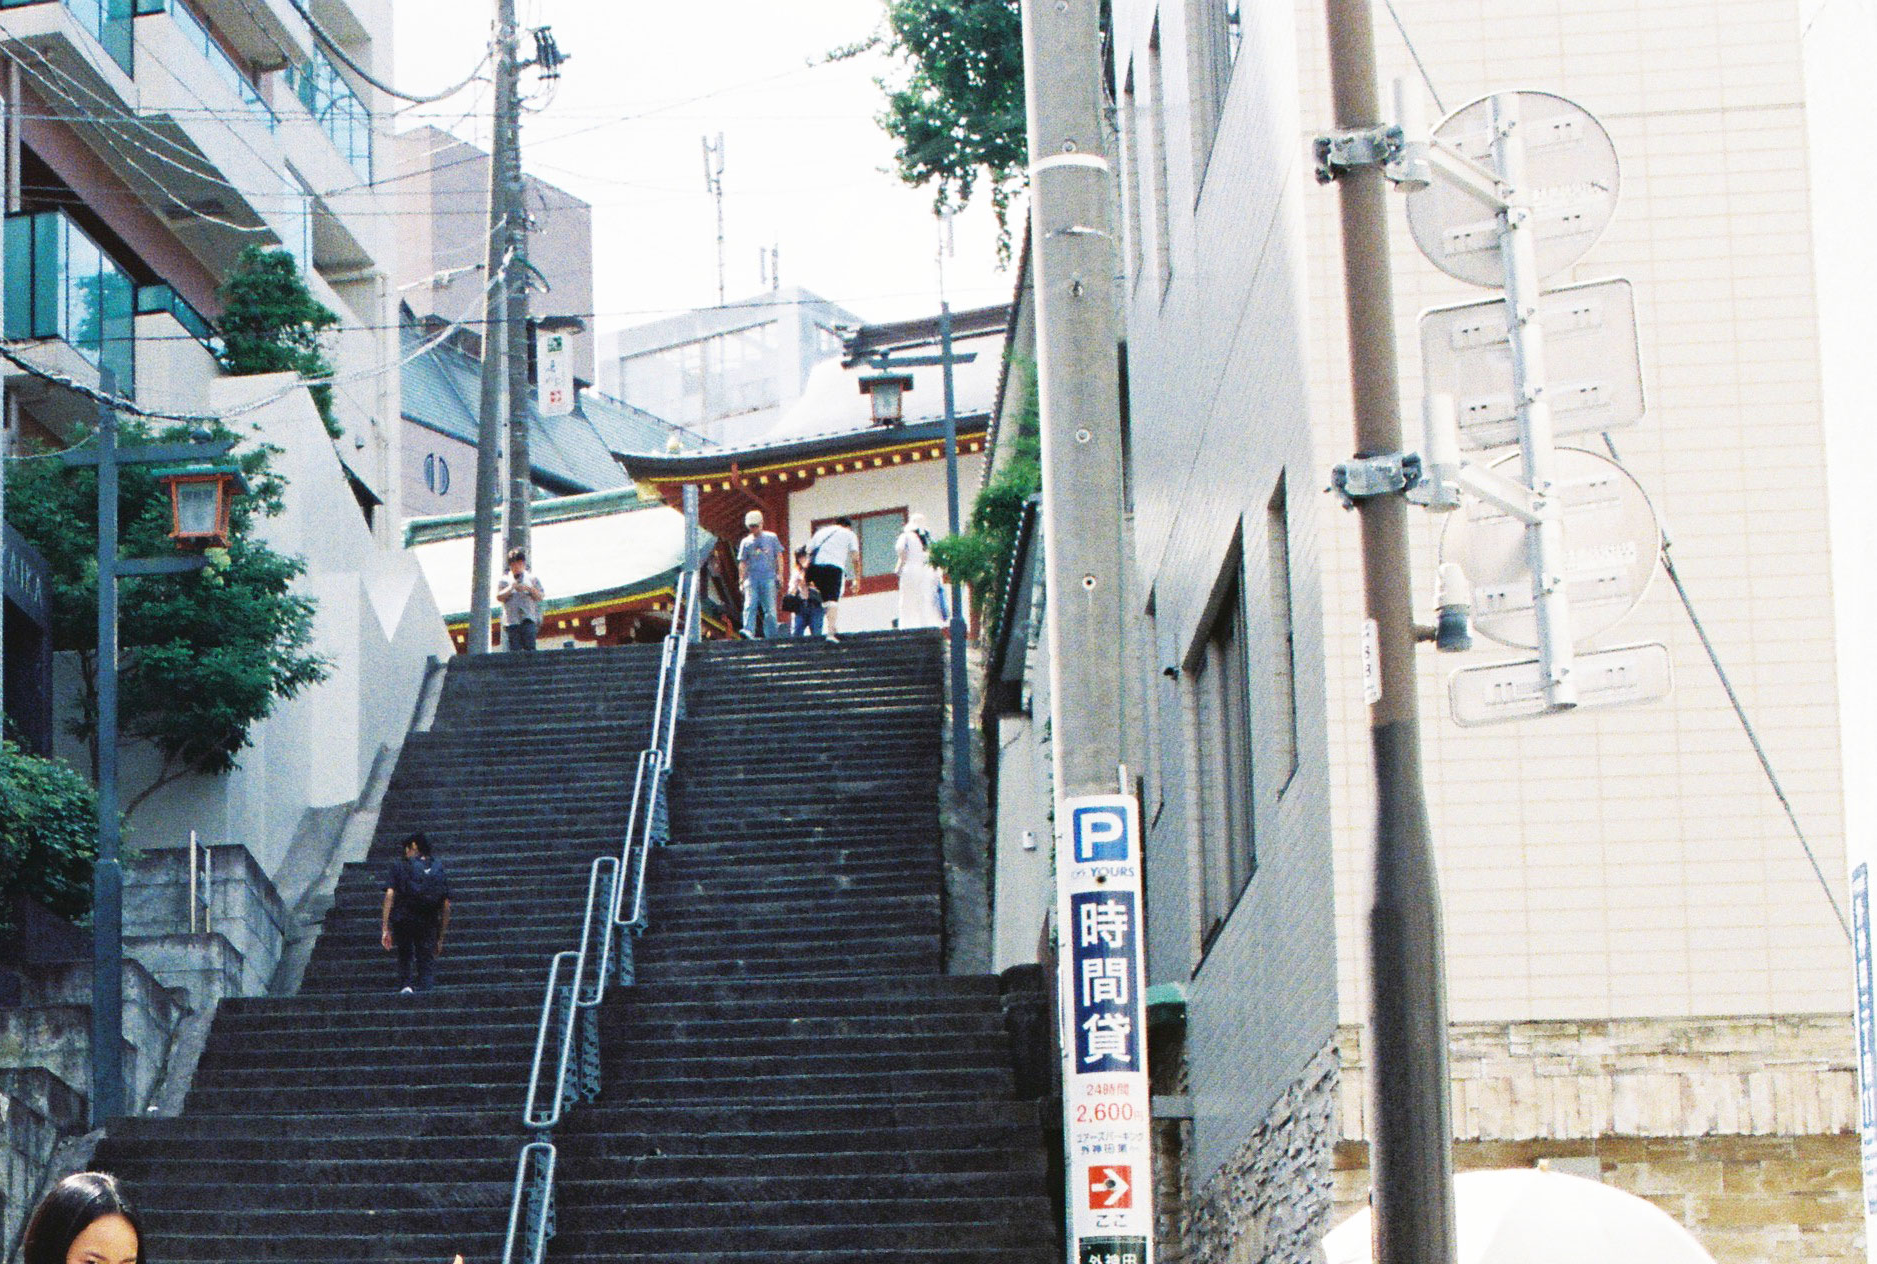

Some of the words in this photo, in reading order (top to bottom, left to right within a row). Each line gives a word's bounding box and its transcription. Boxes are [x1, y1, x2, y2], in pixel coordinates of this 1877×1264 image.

[1080, 811, 1124, 858] P
[1091, 866, 1135, 878] YOURS
[1080, 900, 1131, 1064] 時間貸
[1086, 1083, 1130, 1096] 24時間
[1096, 1214, 1128, 1228] ここ
